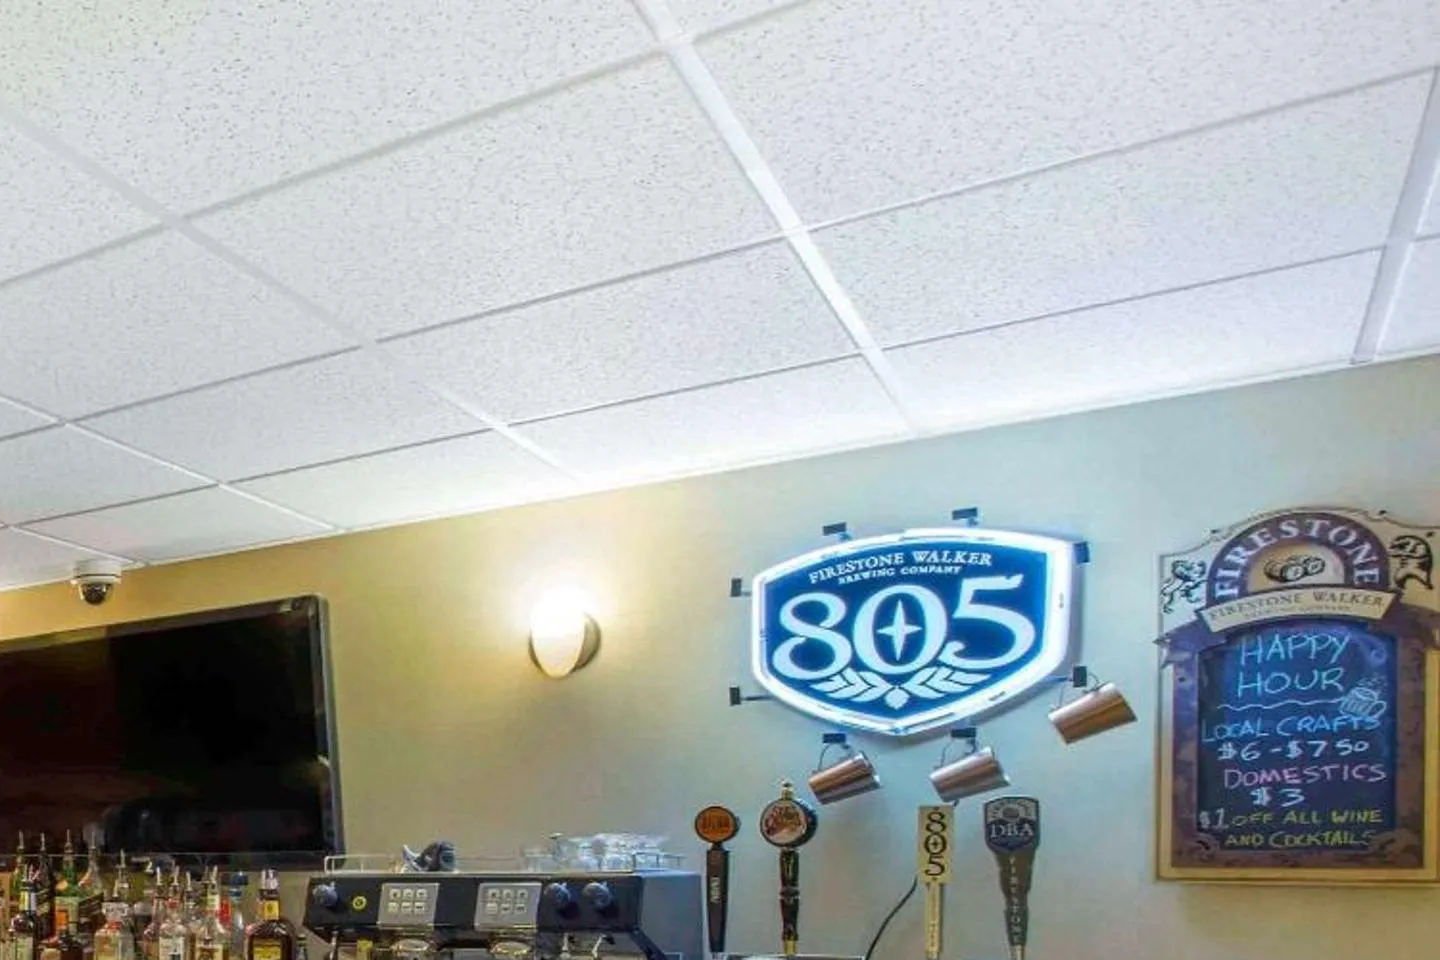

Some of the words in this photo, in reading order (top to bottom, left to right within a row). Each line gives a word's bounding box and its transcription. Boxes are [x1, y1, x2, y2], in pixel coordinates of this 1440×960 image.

[809, 552, 904, 584] FIRESTONE
[911, 550, 993, 567] WALKER
[1214, 519, 1380, 600] FIRESTONE
[838, 567, 896, 585] BREWING
[901, 565, 962, 577] COMPANY
[1312, 590, 1384, 607] WALKER
[772, 573, 1037, 680] 805
[1240, 633, 1351, 665] HAPPY
[1238, 667, 1346, 697] HOUR
[1202, 716, 1269, 742] LOCAL
[1276, 714, 1381, 736] CRAFTS
[1223, 764, 1387, 789] DOMESTICS
[990, 823, 1034, 838] DBA
[1230, 810, 1273, 827] OFF
[1283, 809, 1322, 825] ALL
[1331, 809, 1383, 825] WINE
[924, 811, 947, 876] 805
[1225, 833, 1264, 847] AND
